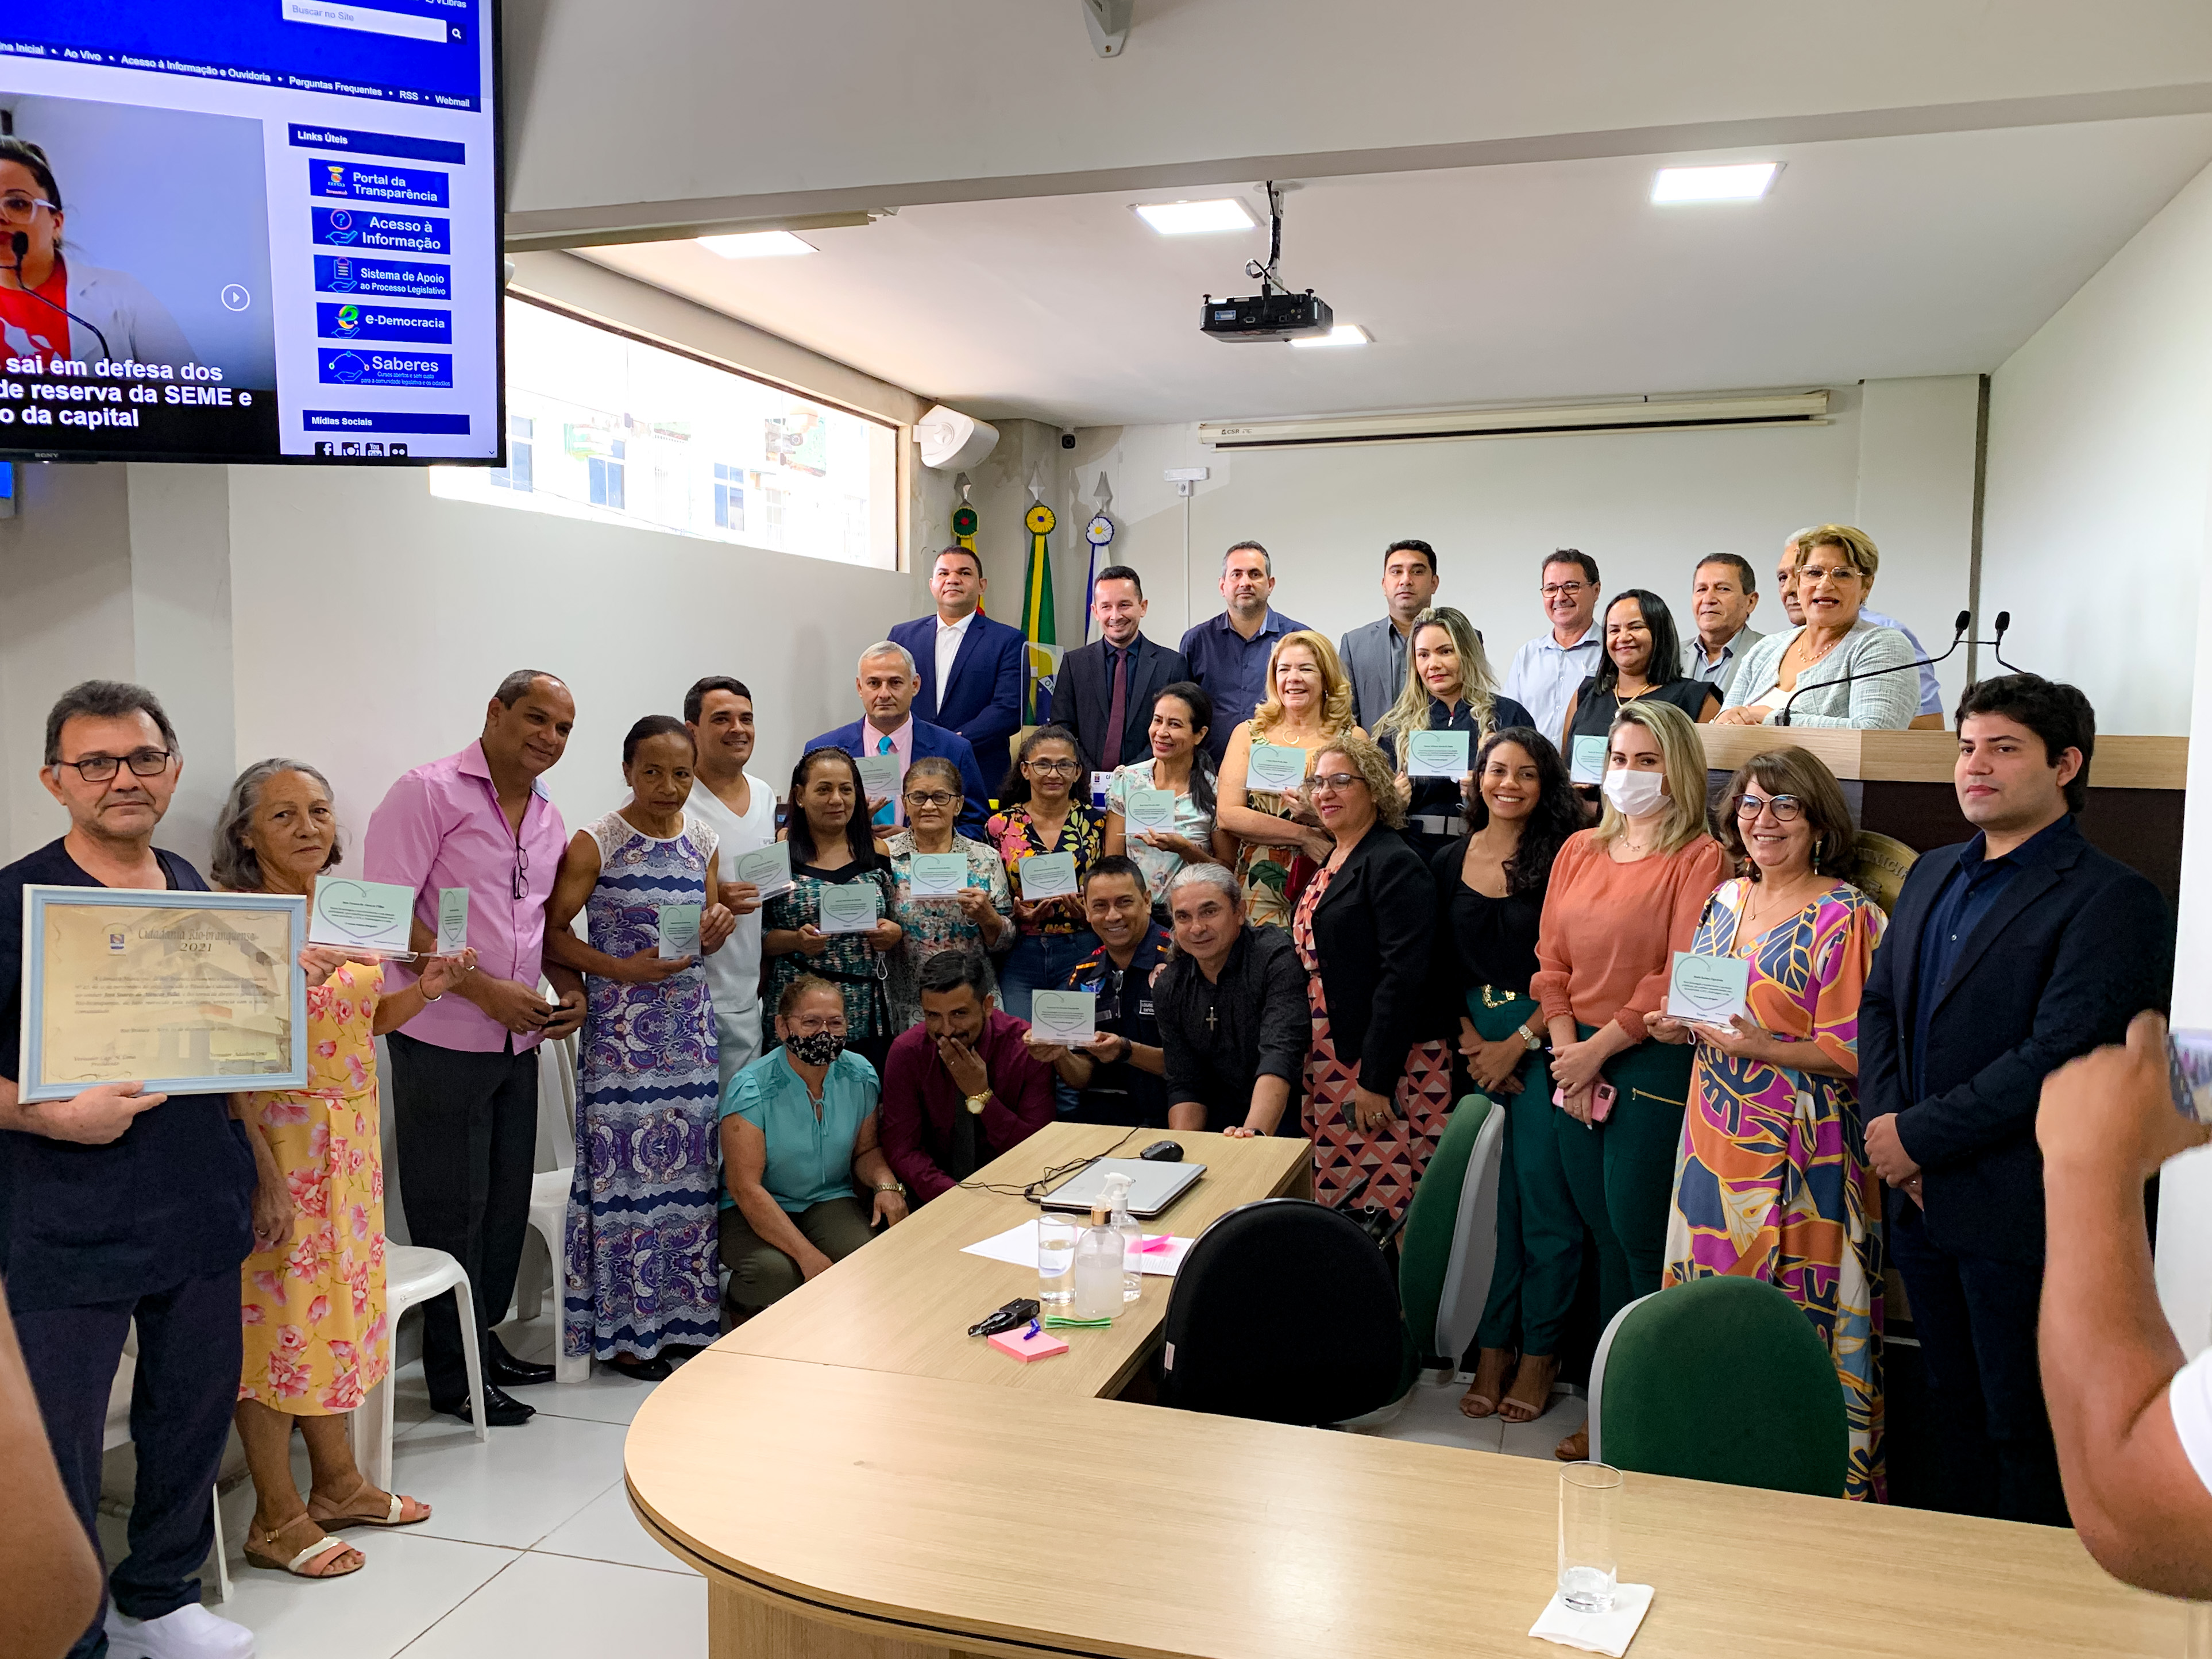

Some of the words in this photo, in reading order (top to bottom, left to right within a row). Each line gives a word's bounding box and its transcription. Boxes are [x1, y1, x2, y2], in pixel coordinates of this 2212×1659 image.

[292, 5, 323, 17] Buscar
[325, 11, 335, 19] no
[338, 11, 354, 22] Site
[16, 43, 44, 55] Inicial
[64, 48, 78, 59] Ao
[80, 50, 102, 62] Vivo
[121, 55, 156, 68] Acesso
[158, 60, 165, 69] à
[167, 60, 217, 76] Informação
[228, 68, 271, 82] Ouvidoria
[289, 76, 333, 90] Perguntas
[335, 82, 383, 97] Frequentes
[399, 90, 419, 101] RSS
[435, 95, 470, 107] Webmail
[298, 131, 323, 142] Links
[325, 132, 348, 144] Úteis
[353, 172, 388, 185] Portal
[391, 176, 406, 187] da
[353, 183, 438, 202] Transparência
[369, 216, 421, 232] Acesso
[424, 221, 433, 233] à
[362, 232, 441, 250] Informação
[361, 268, 400, 280] Sistema
[402, 272, 415, 281] de
[416, 272, 445, 284] Apoio
[372, 282, 406, 293] Processo
[407, 285, 446, 296] Legislativo
[365, 314, 445, 328] e-Democracia
[6, 355, 44, 375] sai
[50, 360, 87, 376] em
[95, 358, 173, 379] defesa
[180, 362, 223, 381] dos
[372, 356, 439, 372] Saberes
[31, 384, 122, 403] reserva
[129, 384, 158, 403] da
[164, 385, 233, 406] SEME
[239, 392, 252, 407] e
[21, 406, 52, 425] da
[59, 407, 139, 430] capital
[311, 416, 340, 425] Mídias
[341, 418, 373, 426] Sociais
[138, 927, 185, 940] Cidadania
[180, 943, 212, 952] 2021
